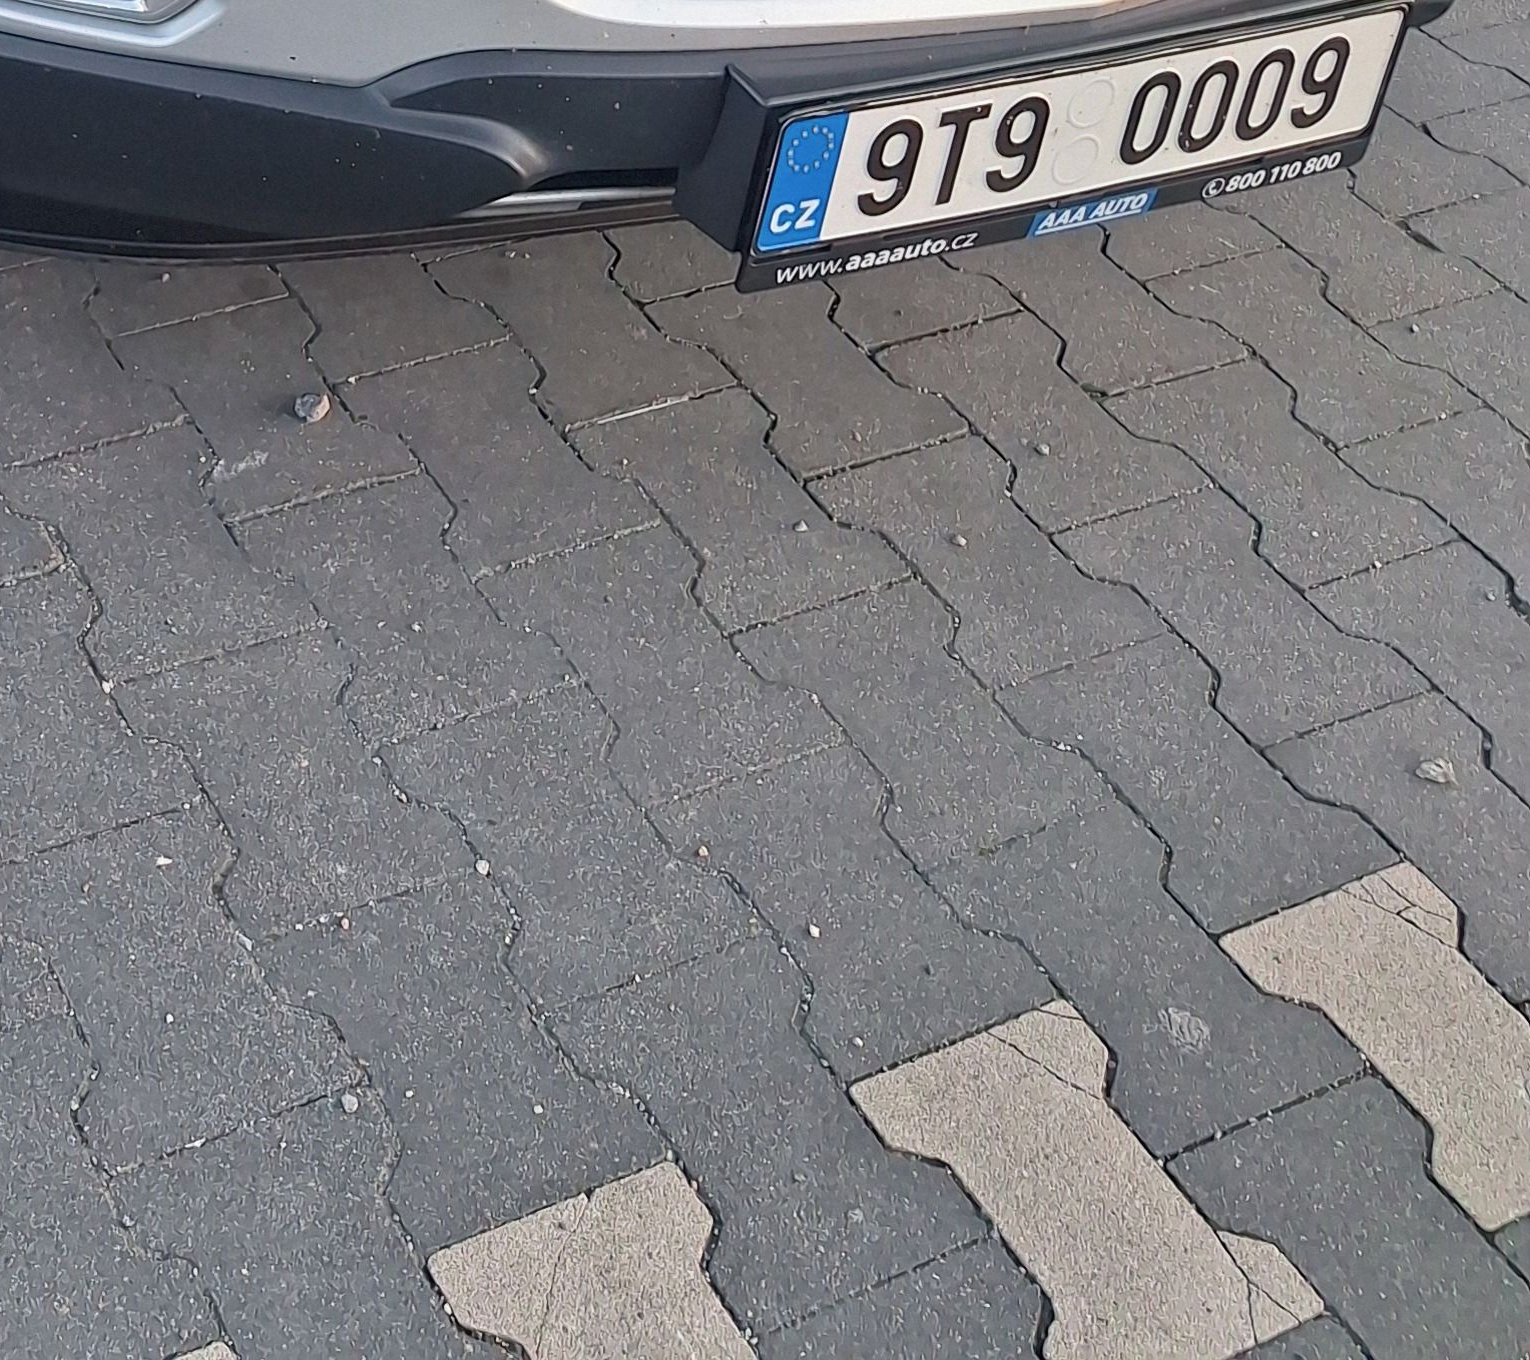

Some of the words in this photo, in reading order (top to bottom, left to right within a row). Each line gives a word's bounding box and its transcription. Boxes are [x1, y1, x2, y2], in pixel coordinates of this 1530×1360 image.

[856, 95, 1050, 216] 9T9
[1119, 35, 1350, 165] 0009
[1224, 169, 1266, 192] 800
[1269, 161, 1302, 183] 110
[1302, 151, 1342, 175] 800
[770, 198, 821, 234] CZ
[1037, 206, 1087, 230] AAA
[1089, 192, 1149, 219] AUTO
[776, 232, 979, 284] www.aaaauto.cz
